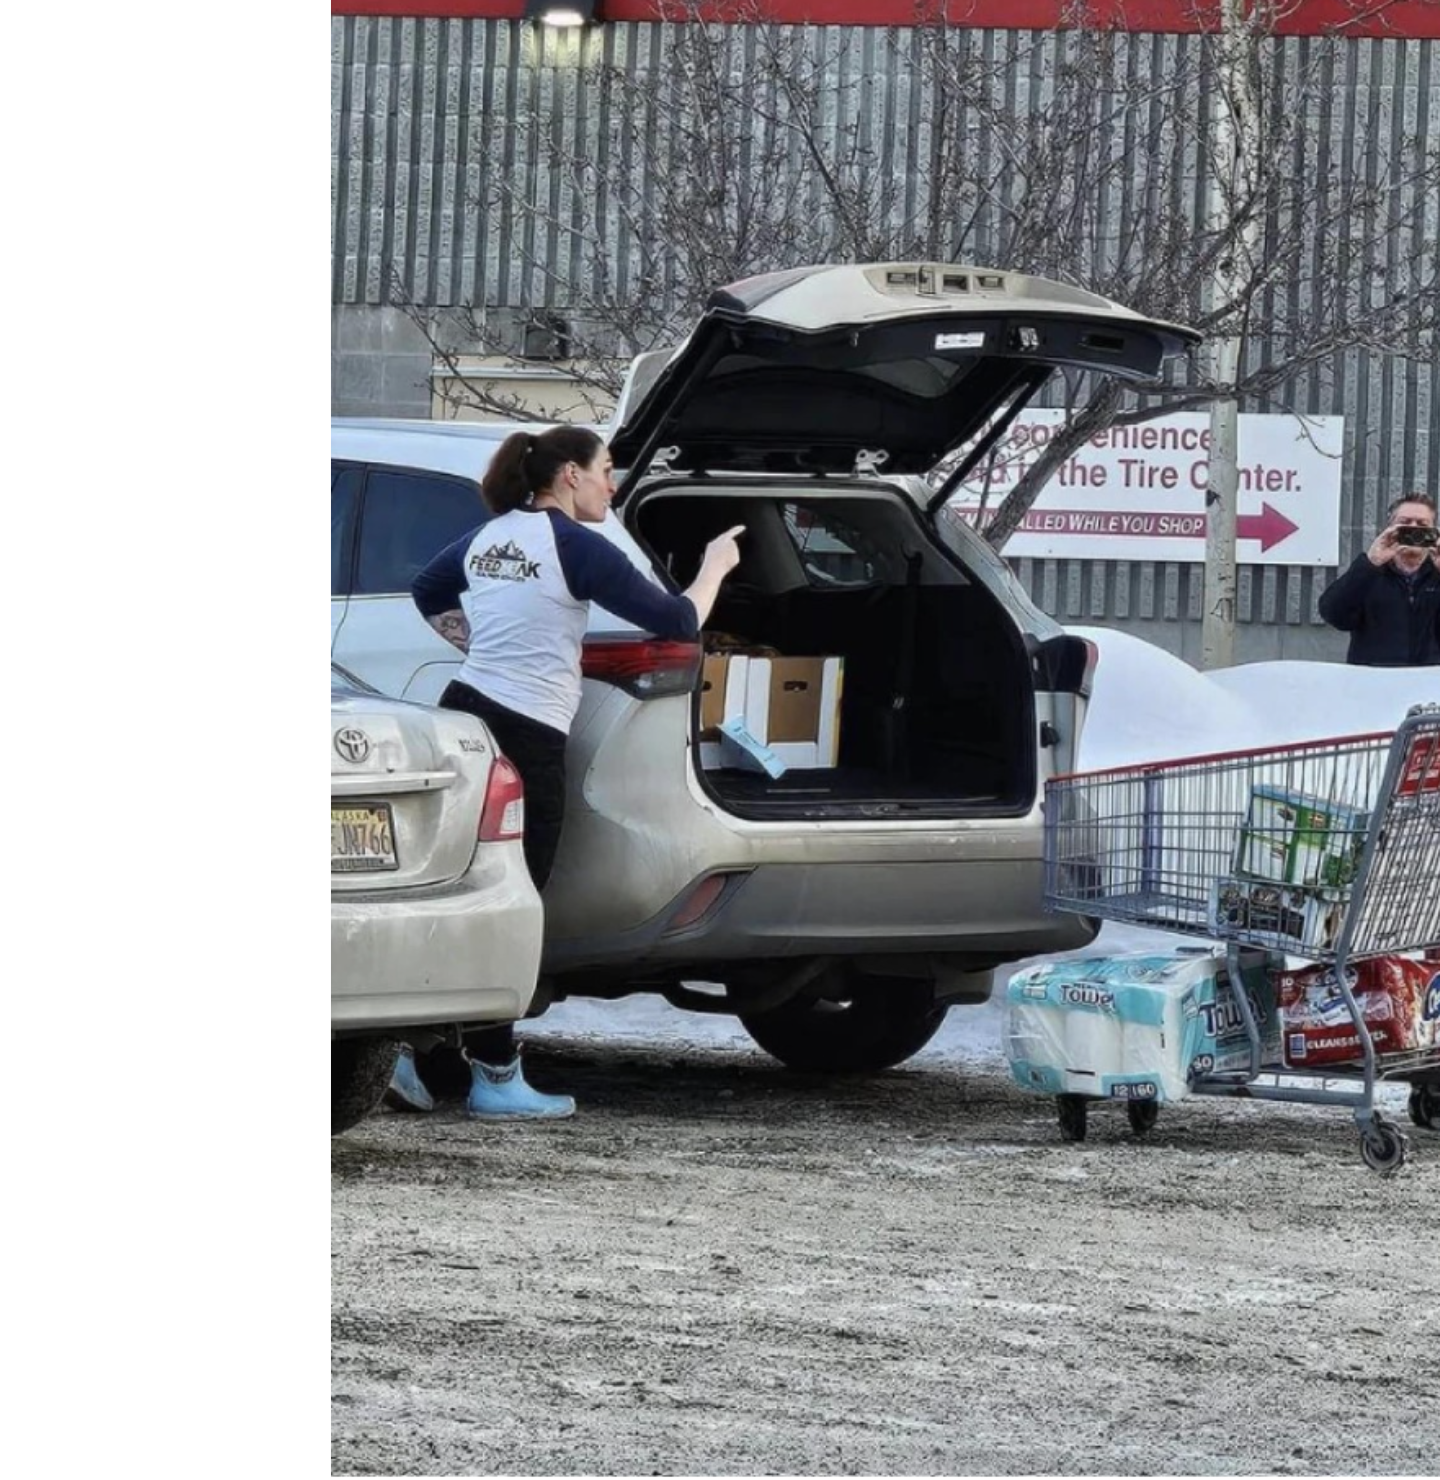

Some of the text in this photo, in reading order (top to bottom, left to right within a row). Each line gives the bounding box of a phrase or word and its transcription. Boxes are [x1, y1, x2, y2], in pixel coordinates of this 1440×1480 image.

[1058, 458, 1107, 487] the
[1118, 459, 1179, 489] Tire
[1190, 461, 1302, 493] Cnter.
[1068, 513, 1119, 533] WHILE
[1119, 515, 1155, 534] YOU
[1157, 515, 1204, 535] SHOP
[331, 809, 369, 821] LASKA
